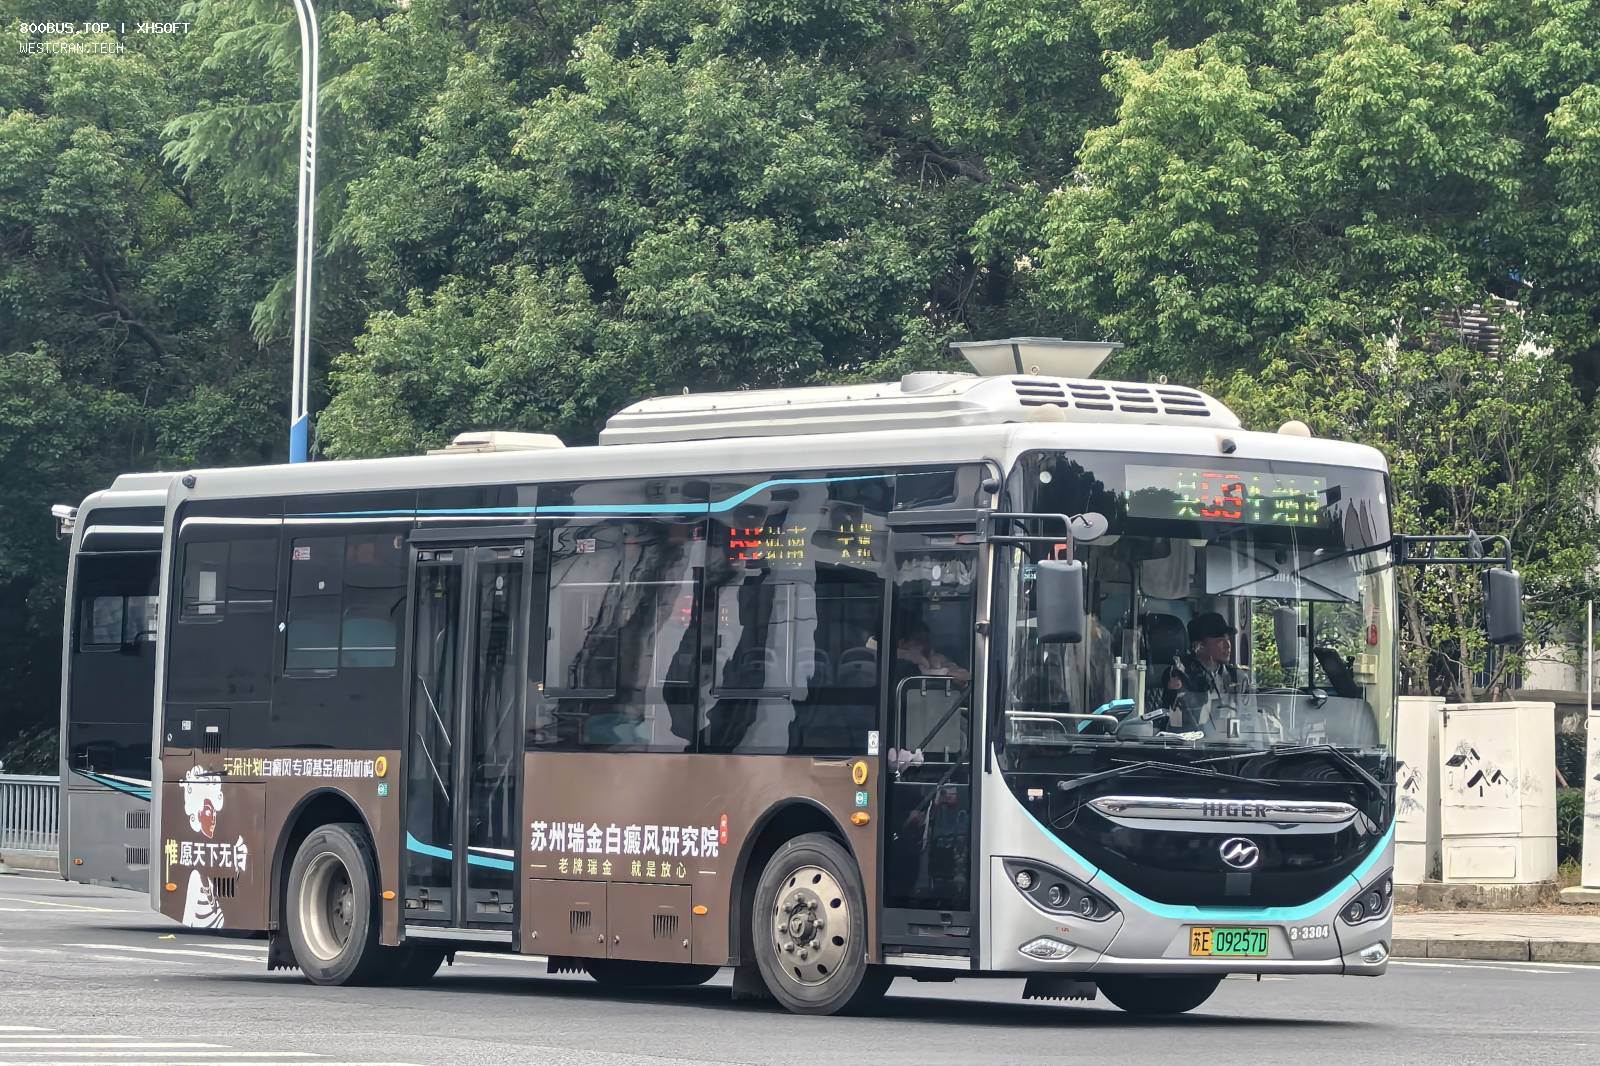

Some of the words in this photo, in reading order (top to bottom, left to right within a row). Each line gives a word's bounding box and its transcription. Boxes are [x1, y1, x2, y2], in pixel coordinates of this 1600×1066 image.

[1202, 802, 1268, 818] HIGER
[530, 820, 719, 858] 苏州瑞金白癜风研究院
[558, 857, 613, 877] 老牌瑞金
[631, 859, 687, 879] 就是放心
